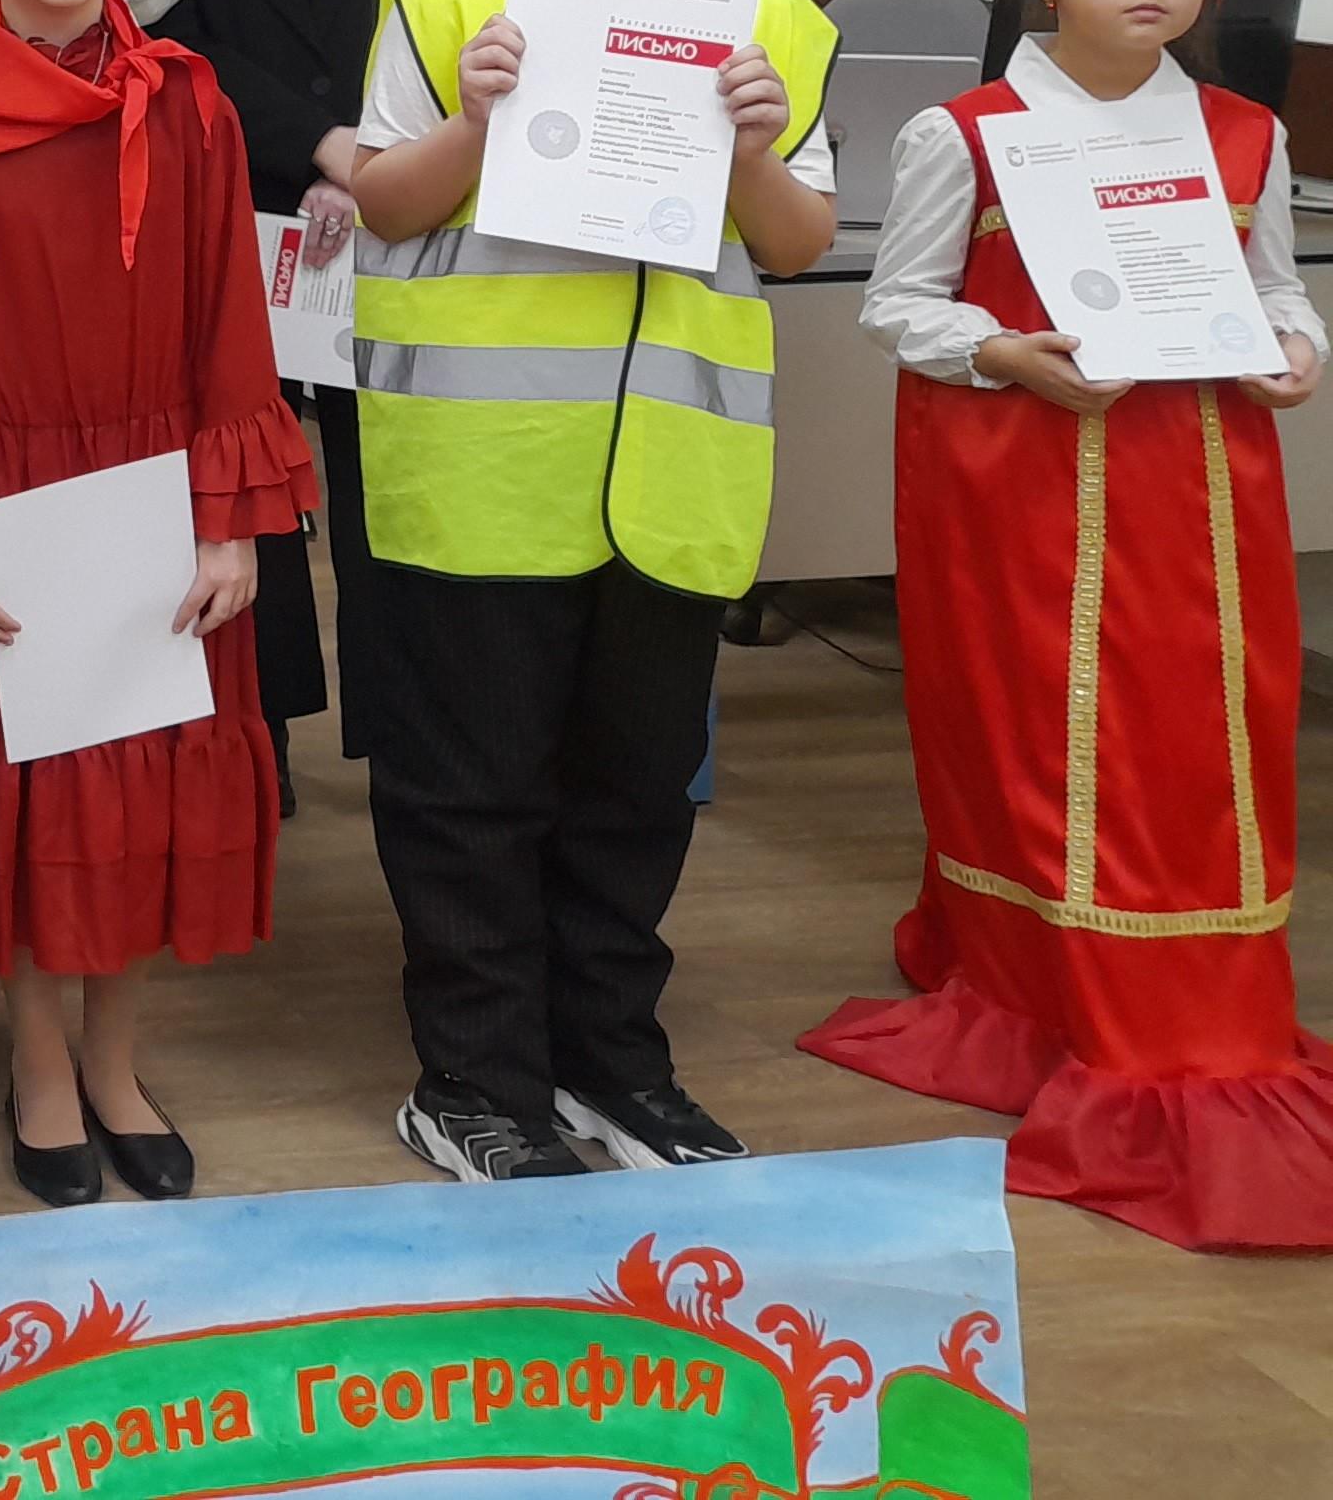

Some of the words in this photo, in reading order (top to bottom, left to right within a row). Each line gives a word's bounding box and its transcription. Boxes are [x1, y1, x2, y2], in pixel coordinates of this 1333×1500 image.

[608, 32, 698, 60] ПИСЬМО
[1096, 183, 1178, 206] ПИСЬМО
[273, 248, 295, 307] ПИСЬМО
[295, 1343, 726, 1435] География
